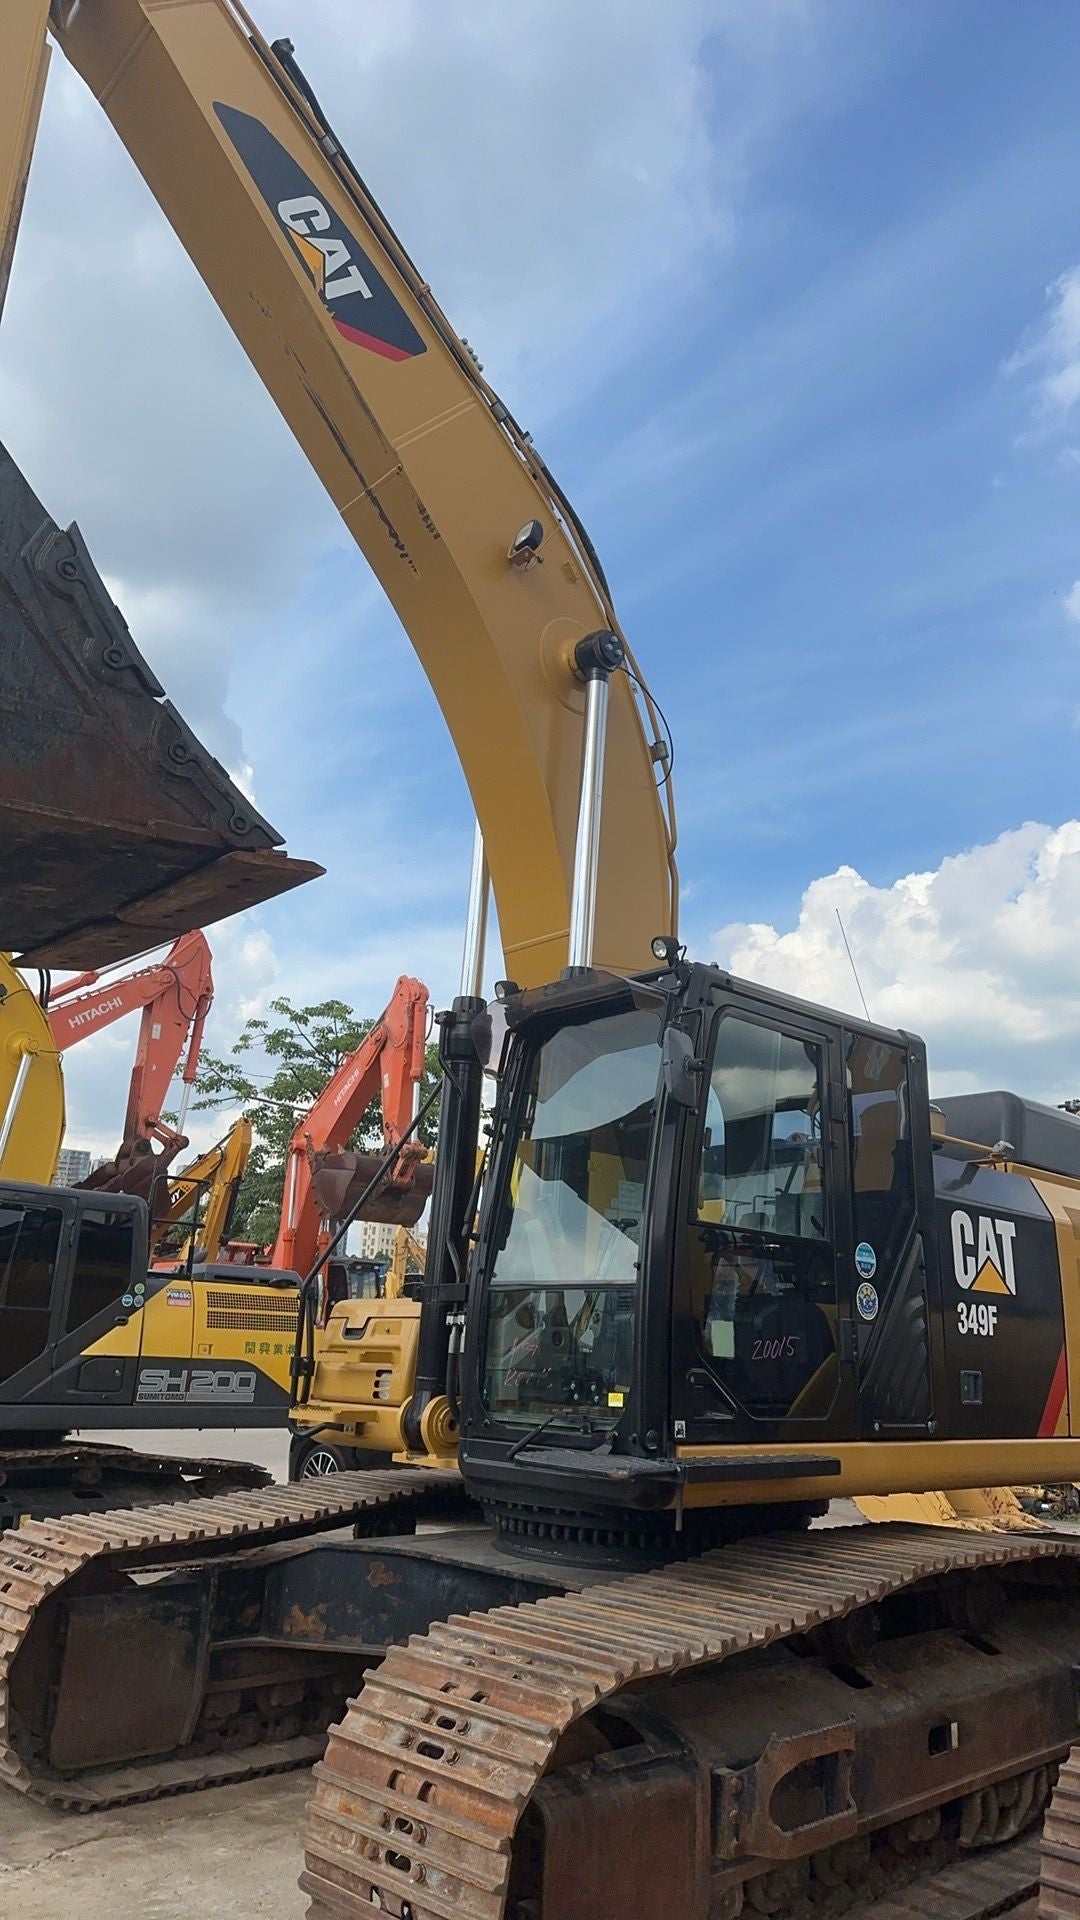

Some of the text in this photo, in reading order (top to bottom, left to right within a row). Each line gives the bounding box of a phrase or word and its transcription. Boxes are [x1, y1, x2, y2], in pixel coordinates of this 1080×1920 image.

[277, 195, 374, 300] CAT
[68, 996, 123, 1029] HITACHI
[333, 1068, 360, 1106] HITACHI
[950, 1209, 1017, 1296] CAT
[956, 1301, 998, 1336] 349F
[751, 1335, 801, 1360] 20015
[137, 1392, 185, 1401] SUMITOMO
[138, 1369, 257, 1392] SH200
